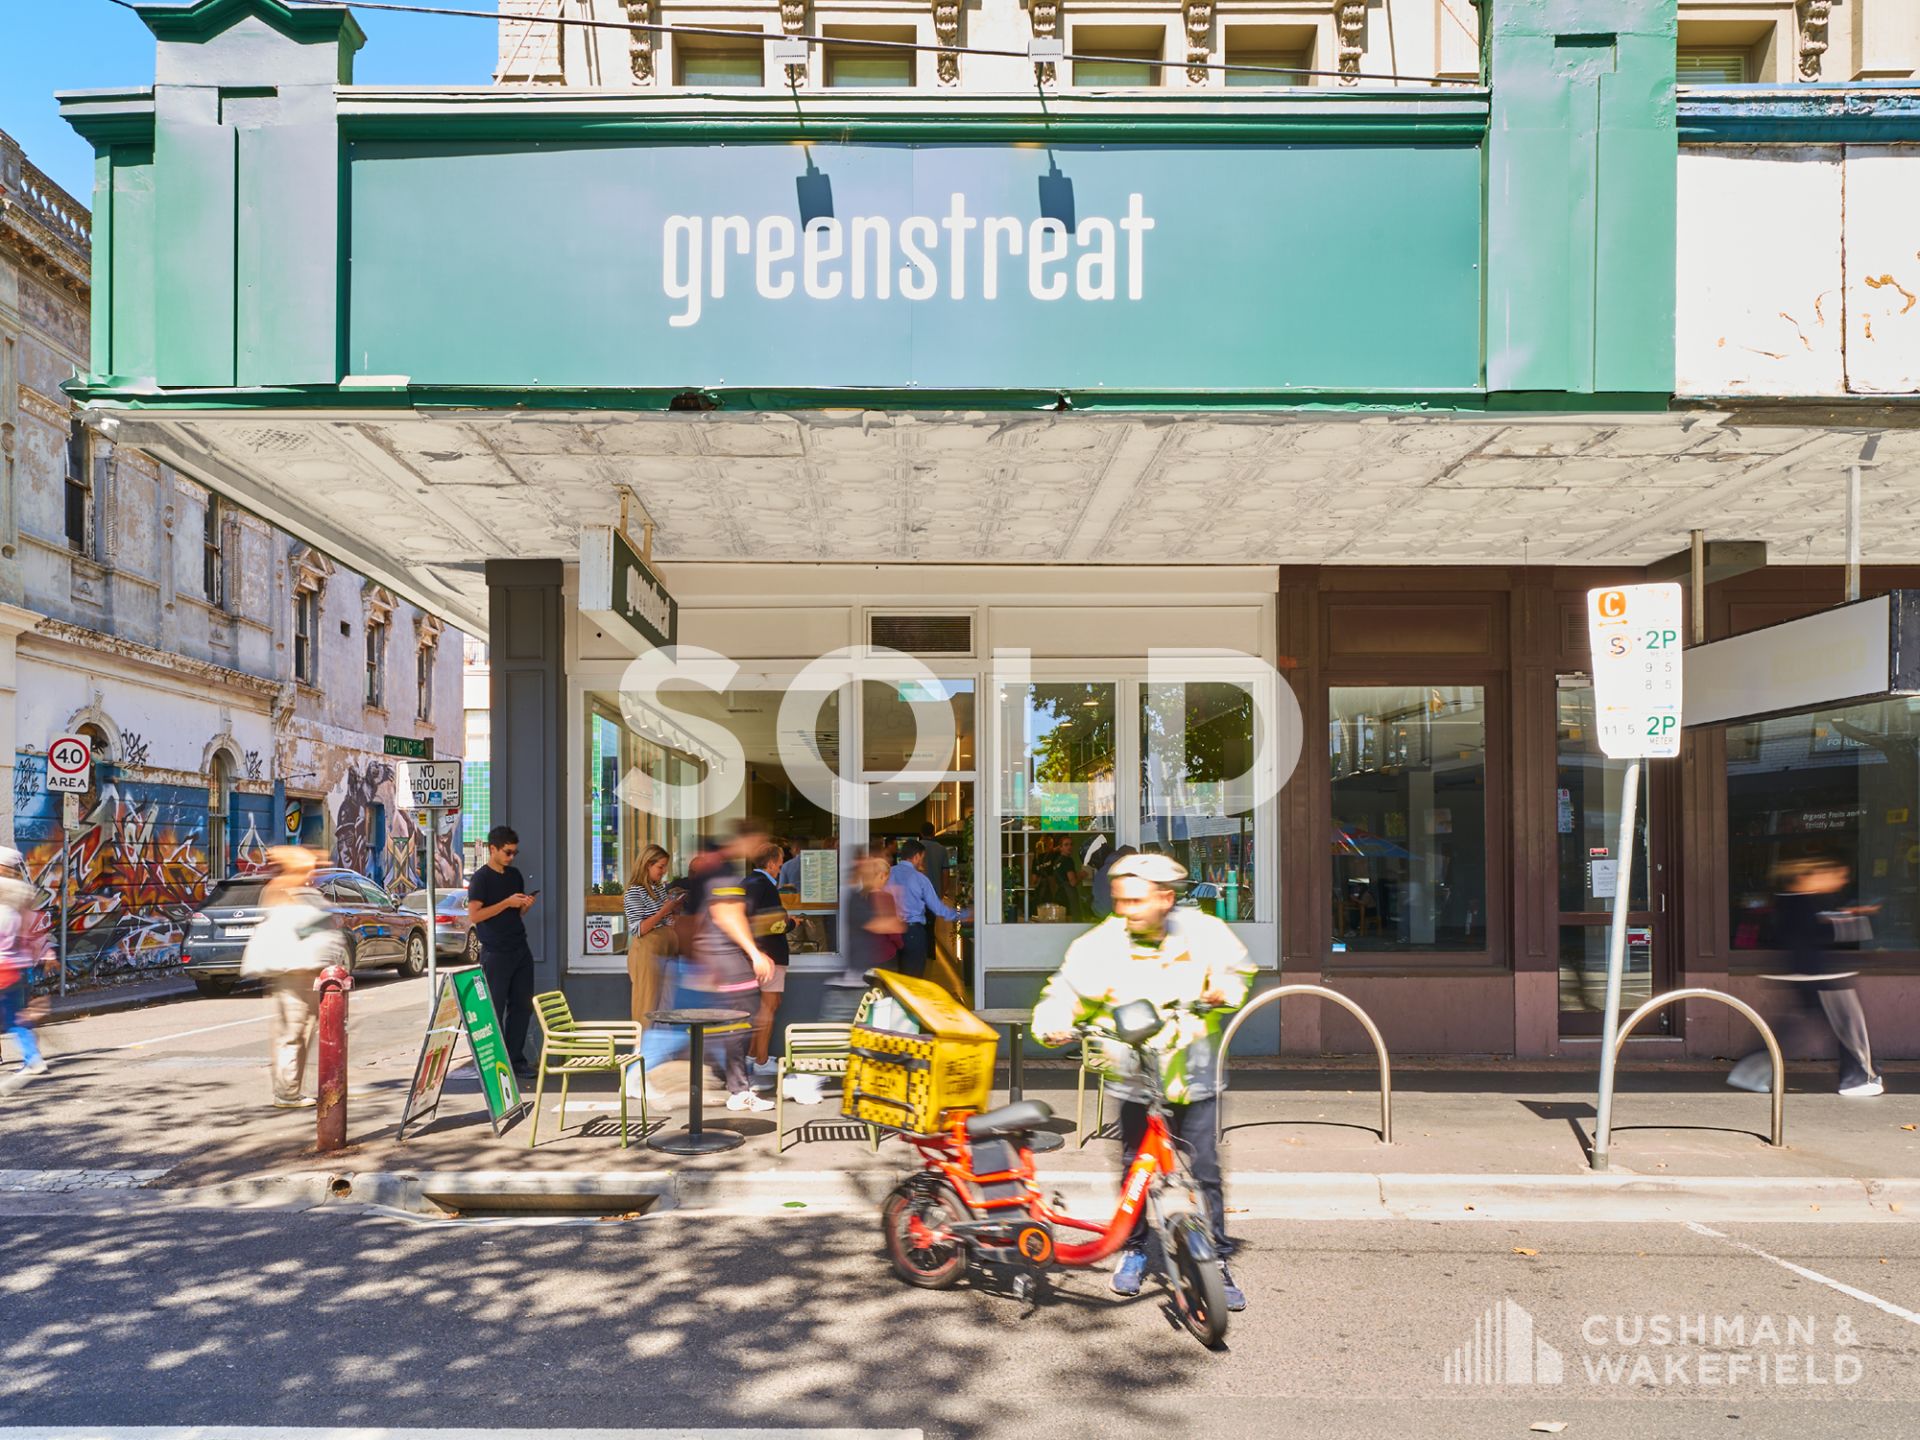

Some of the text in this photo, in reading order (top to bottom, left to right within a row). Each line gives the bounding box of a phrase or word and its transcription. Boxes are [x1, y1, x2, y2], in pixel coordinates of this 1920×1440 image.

[663, 192, 1155, 327] greenstreat
[1646, 630, 1677, 649] 2P
[1647, 716, 1676, 735] 2P
[385, 738, 413, 756] KIPLING
[56, 748, 83, 764] 40
[420, 765, 435, 778] NO
[48, 776, 87, 788] AREA
[403, 778, 454, 791] HROUGH
